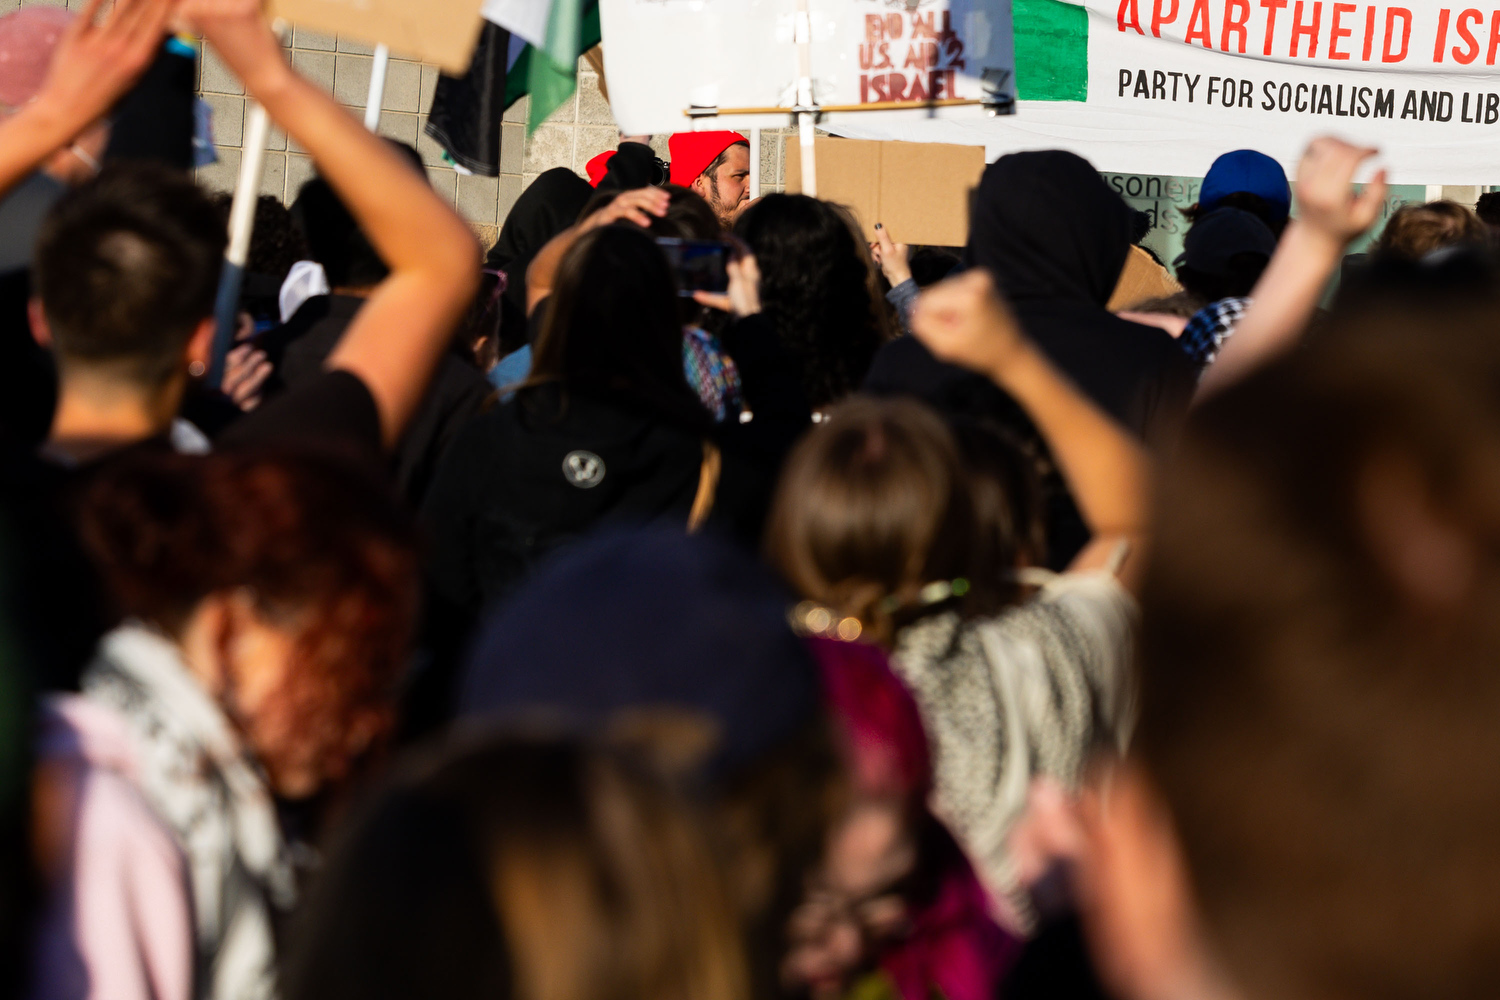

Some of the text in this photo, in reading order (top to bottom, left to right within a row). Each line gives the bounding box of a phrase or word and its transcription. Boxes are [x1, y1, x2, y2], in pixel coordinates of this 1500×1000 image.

[864, 9, 957, 41] END ALL
[903, 41, 940, 70] AID
[946, 39, 966, 71] 2
[859, 68, 966, 103] ISRAEL
[1119, 69, 1200, 103] PARTY
[1208, 77, 1252, 108] FOR
[1262, 81, 1394, 119] SOCIALISM
[1401, 90, 1454, 123] AND
